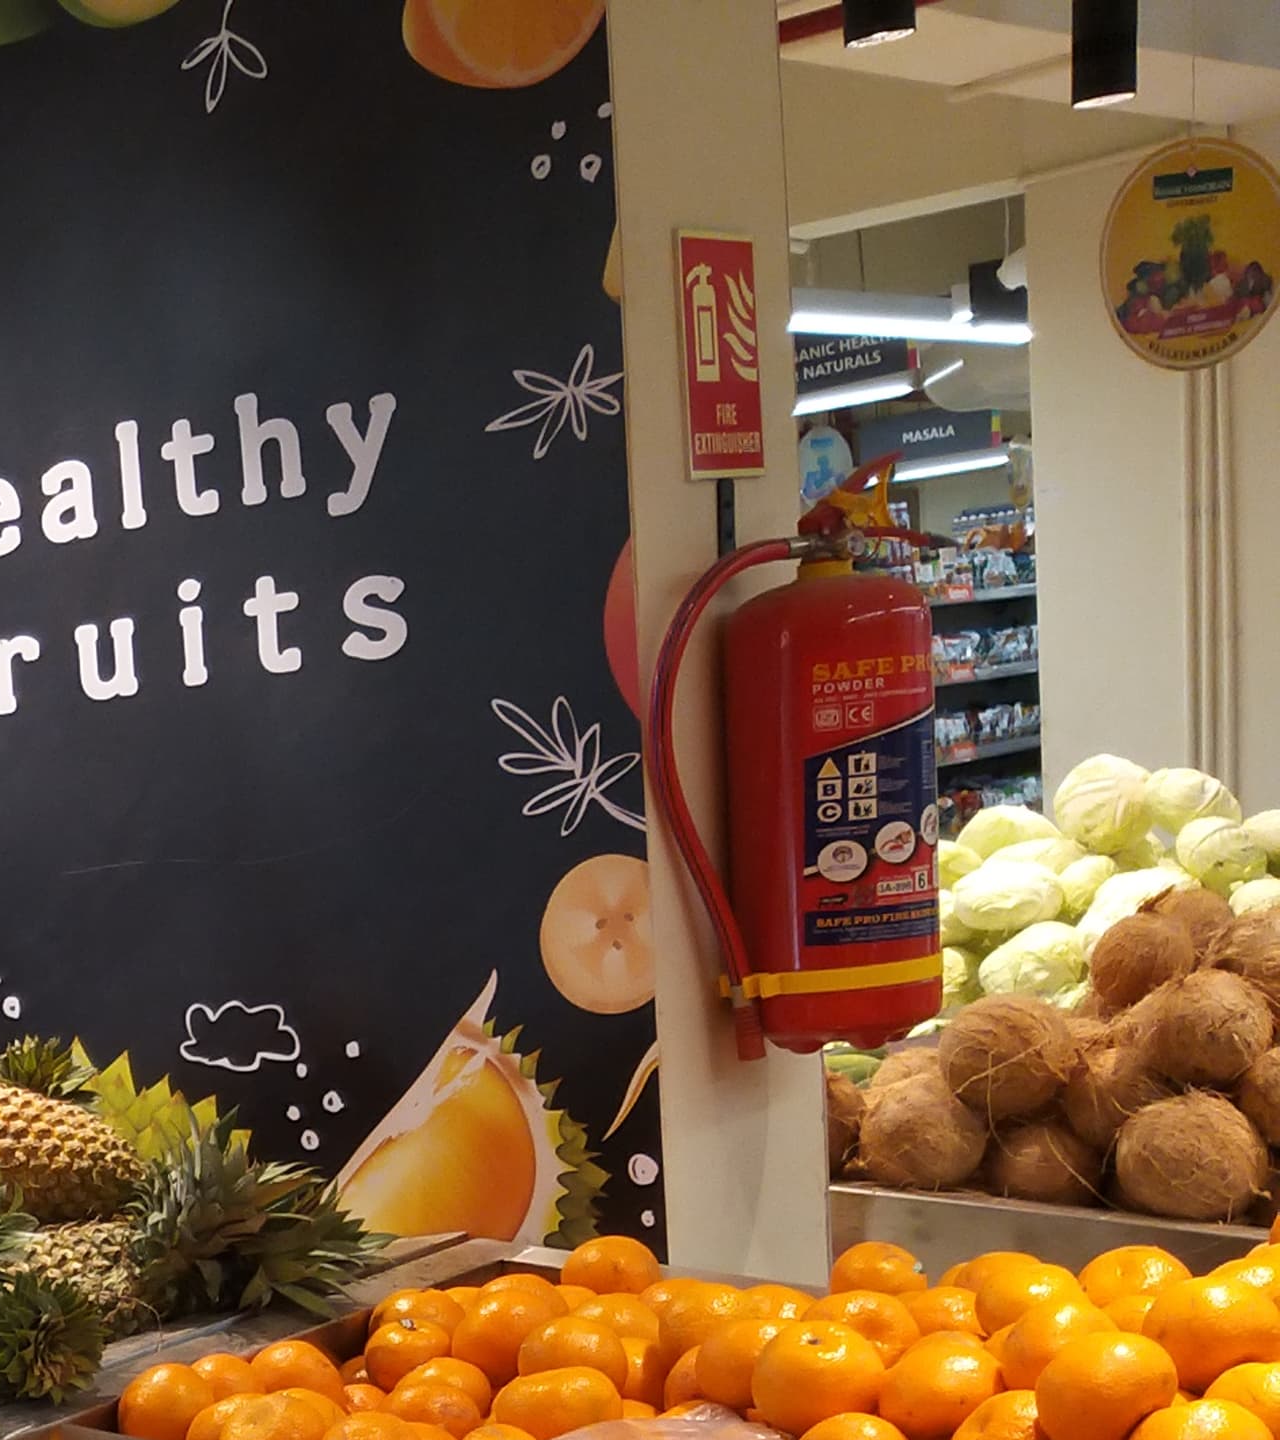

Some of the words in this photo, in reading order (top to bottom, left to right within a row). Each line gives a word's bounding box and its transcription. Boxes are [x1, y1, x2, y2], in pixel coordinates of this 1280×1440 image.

[794, 341, 836, 362] ANIC
[803, 350, 882, 380] NATURALS
[716, 403, 738, 425] FIRE
[902, 424, 955, 443] MASALA
[812, 656, 894, 682] SAFE
[812, 677, 885, 695] POWDER
[822, 783, 837, 797] B
[822, 805, 838, 820] C
[917, 872, 927, 890] 6
